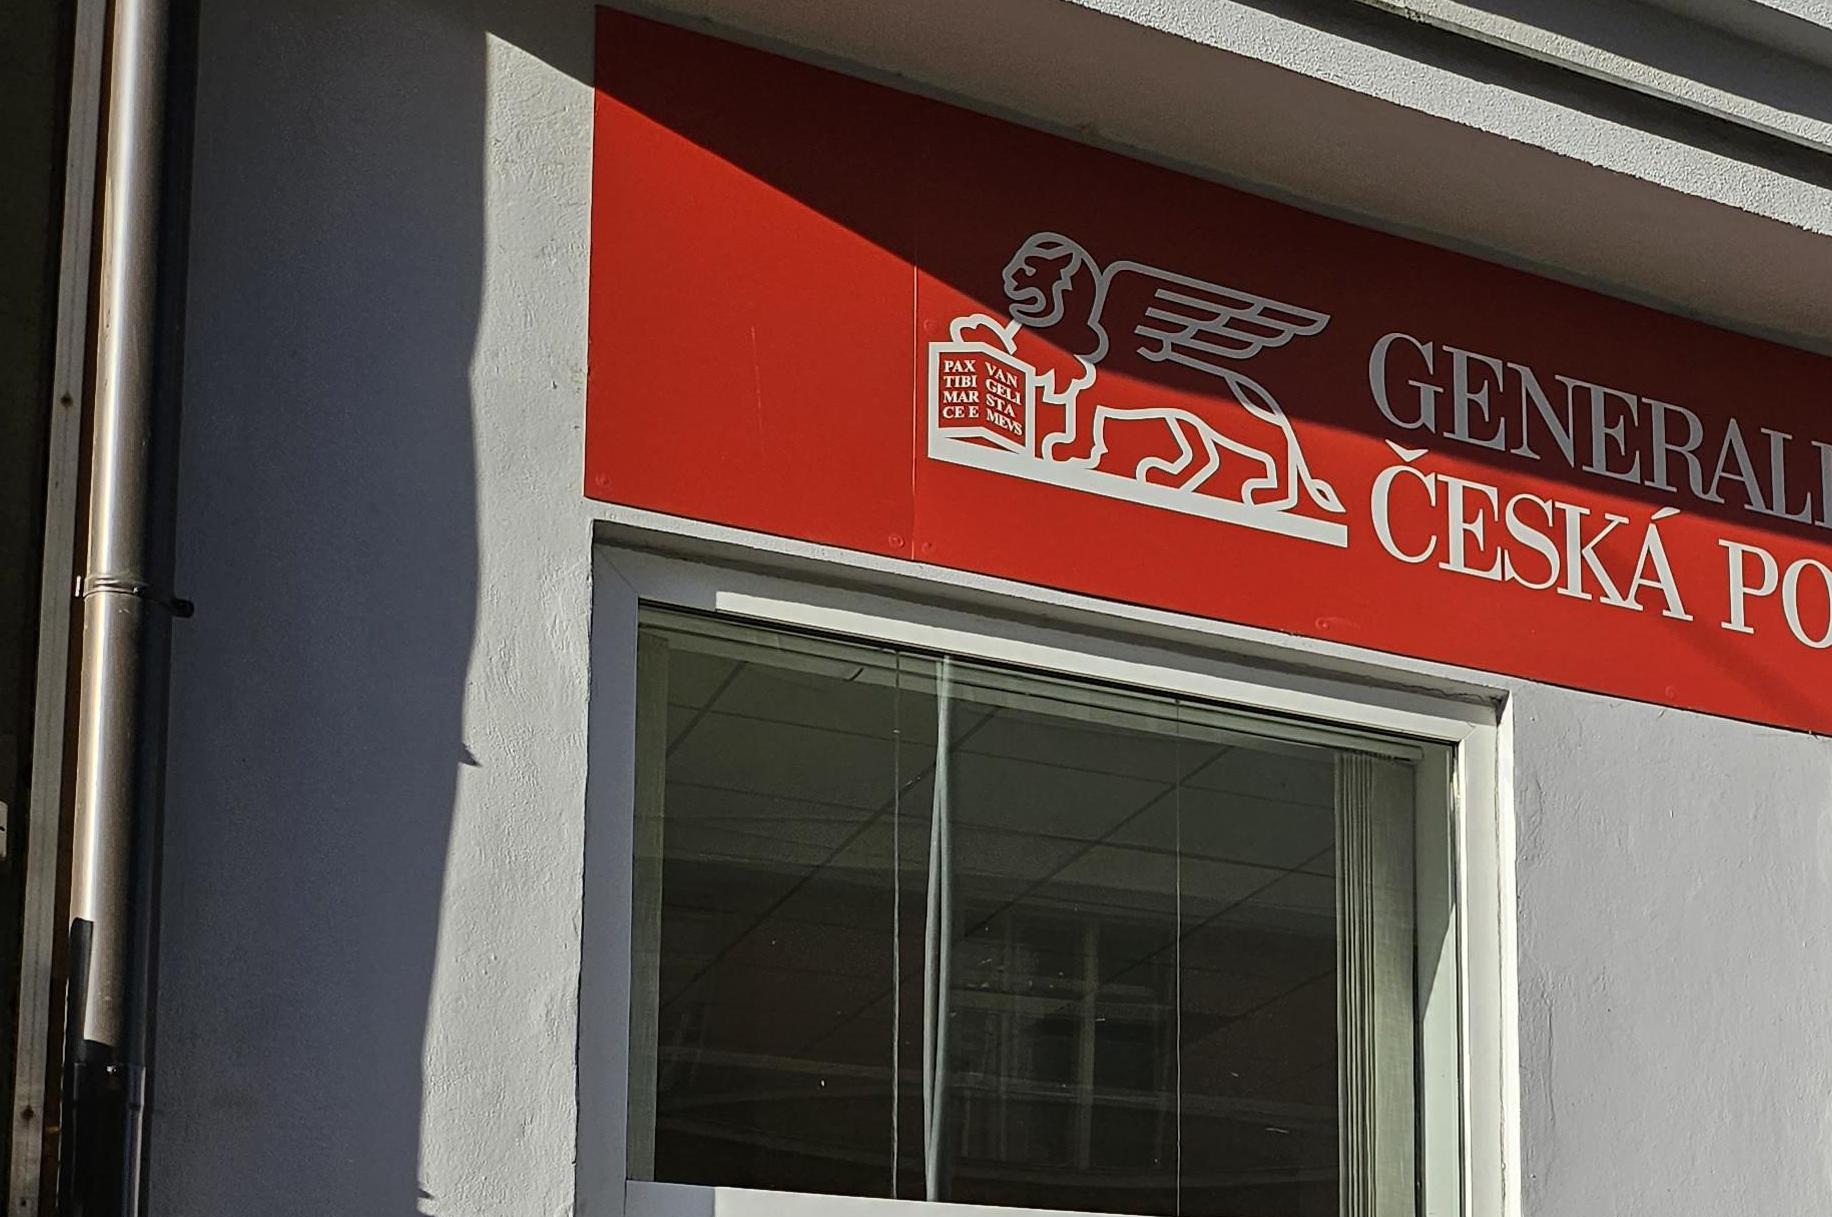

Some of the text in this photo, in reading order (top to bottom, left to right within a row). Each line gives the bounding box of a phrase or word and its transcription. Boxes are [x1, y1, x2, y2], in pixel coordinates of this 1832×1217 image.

[943, 360, 976, 373] PAX
[984, 361, 1018, 388] VAN
[943, 375, 977, 388] TIBI
[984, 379, 1022, 405] GELI
[943, 391, 980, 403] MAR
[986, 394, 1016, 418] STA
[942, 405, 980, 418] CE E
[986, 408, 1023, 436] MEVS
[1370, 438, 1694, 622] ČESKÁ
